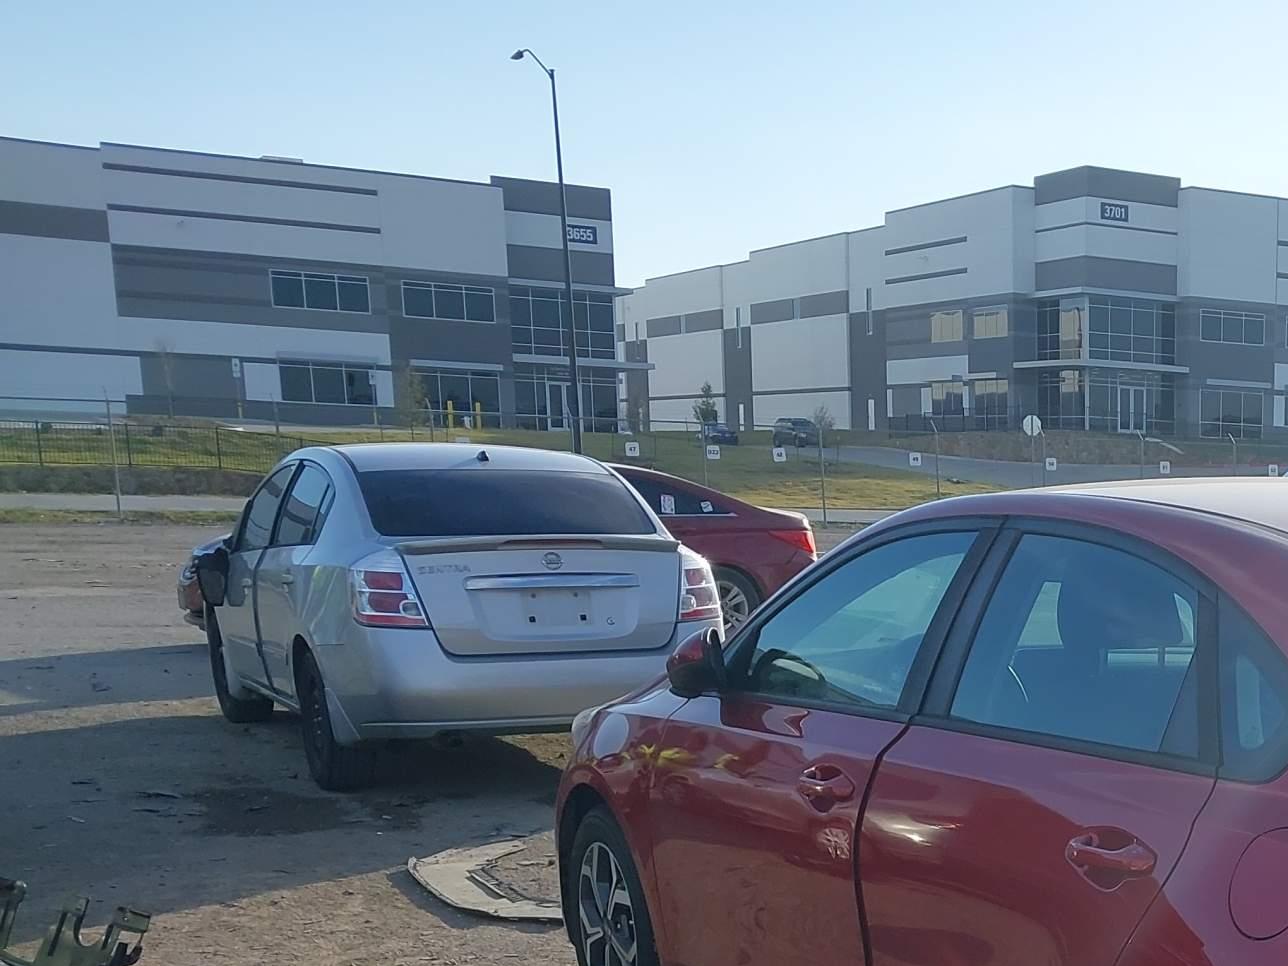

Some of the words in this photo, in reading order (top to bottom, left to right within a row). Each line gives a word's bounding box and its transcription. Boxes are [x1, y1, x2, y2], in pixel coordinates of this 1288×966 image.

[1104, 205, 1125, 219] 3701
[567, 227, 593, 241] 3655
[416, 564, 472, 575] SENTRA
